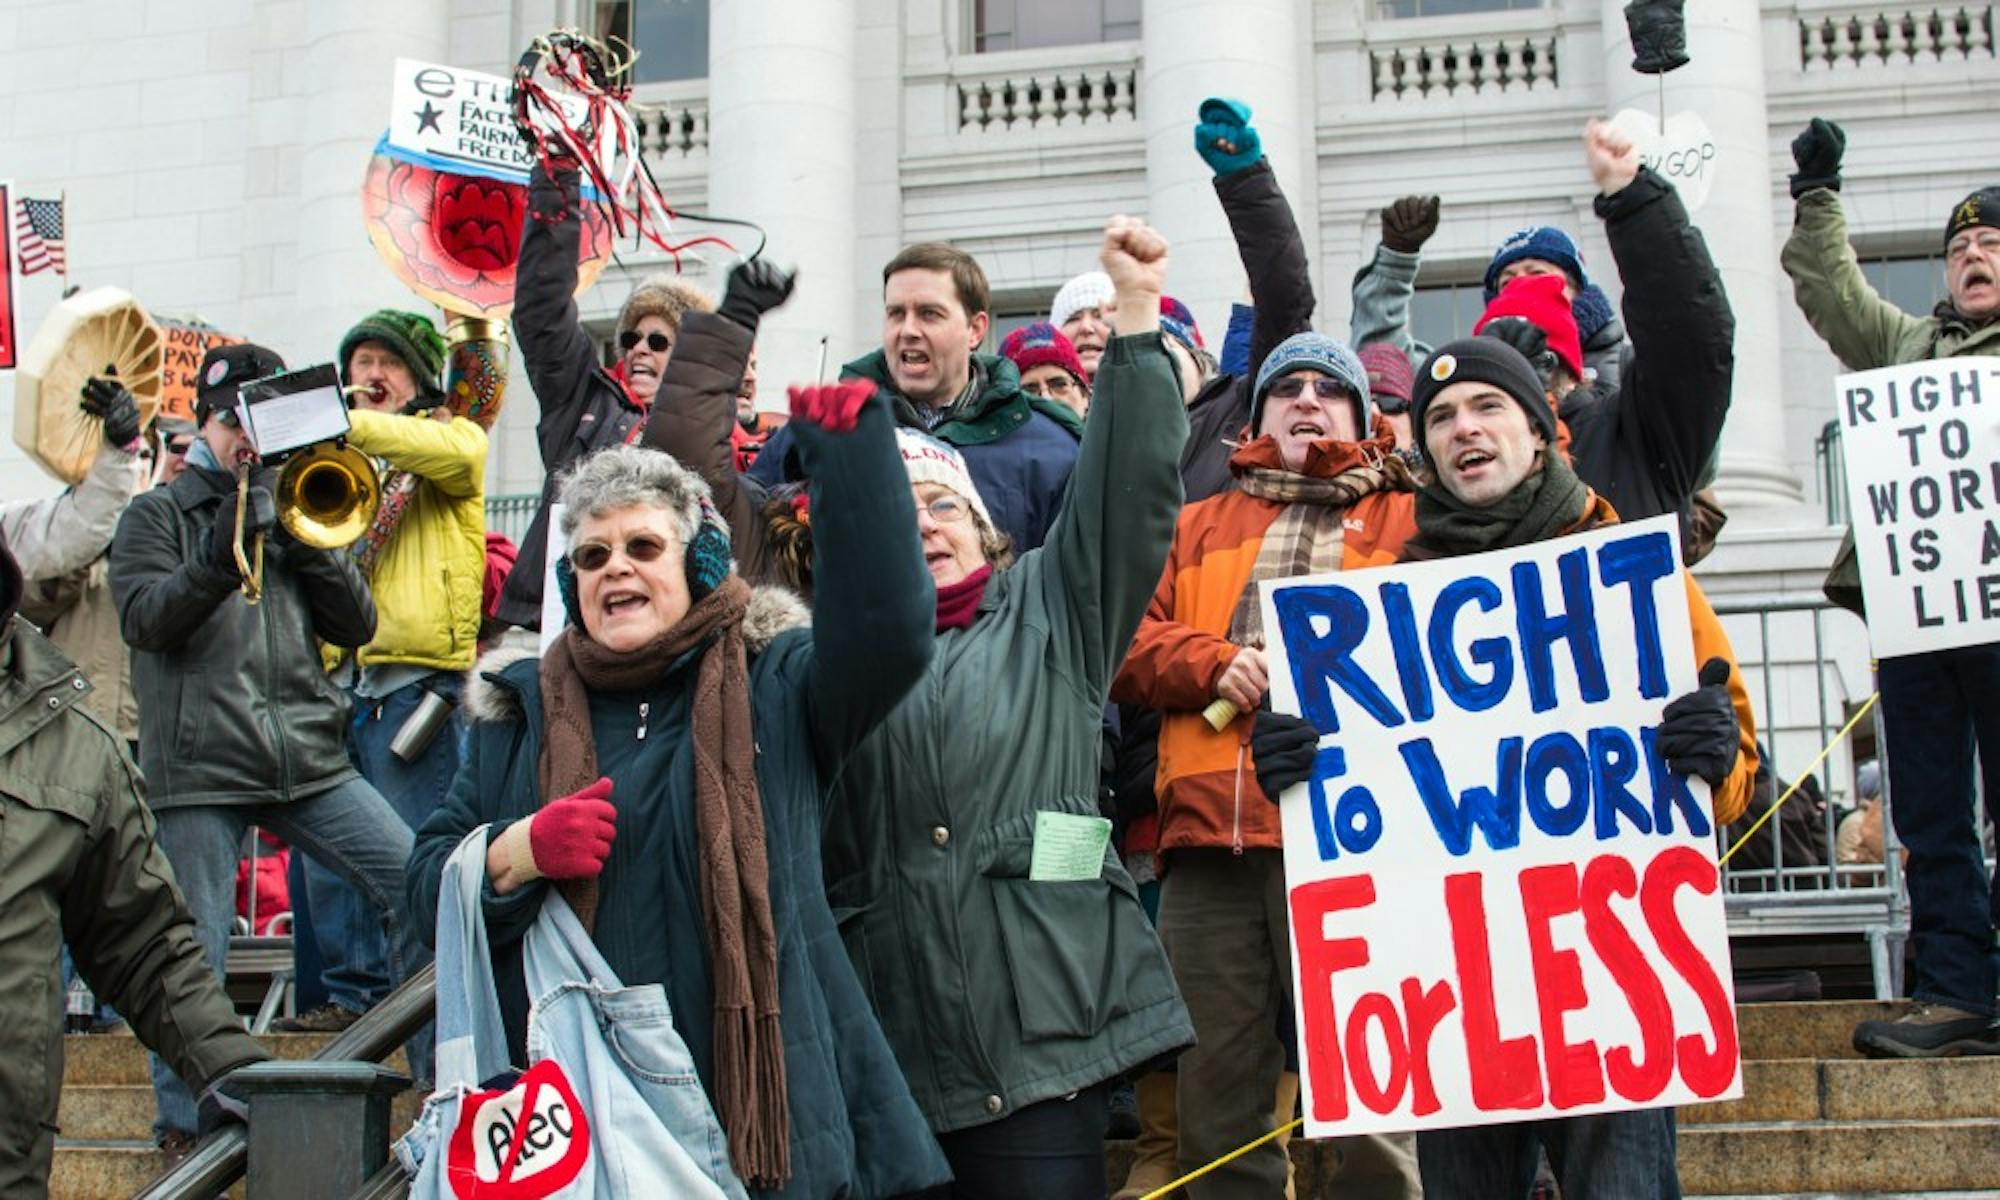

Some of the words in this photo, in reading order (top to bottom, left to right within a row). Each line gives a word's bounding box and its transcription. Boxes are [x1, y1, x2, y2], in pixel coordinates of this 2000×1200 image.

[457, 137, 535, 166] FREEDO
[1666, 142, 1715, 181] GOP
[164, 347, 200, 369] PAY
[1846, 369, 2000, 427] RIGH
[1898, 418, 1971, 467] TO
[1886, 528, 1941, 577] IS
[1913, 574, 2000, 628] LIE
[1272, 532, 1674, 735] RIGHT
